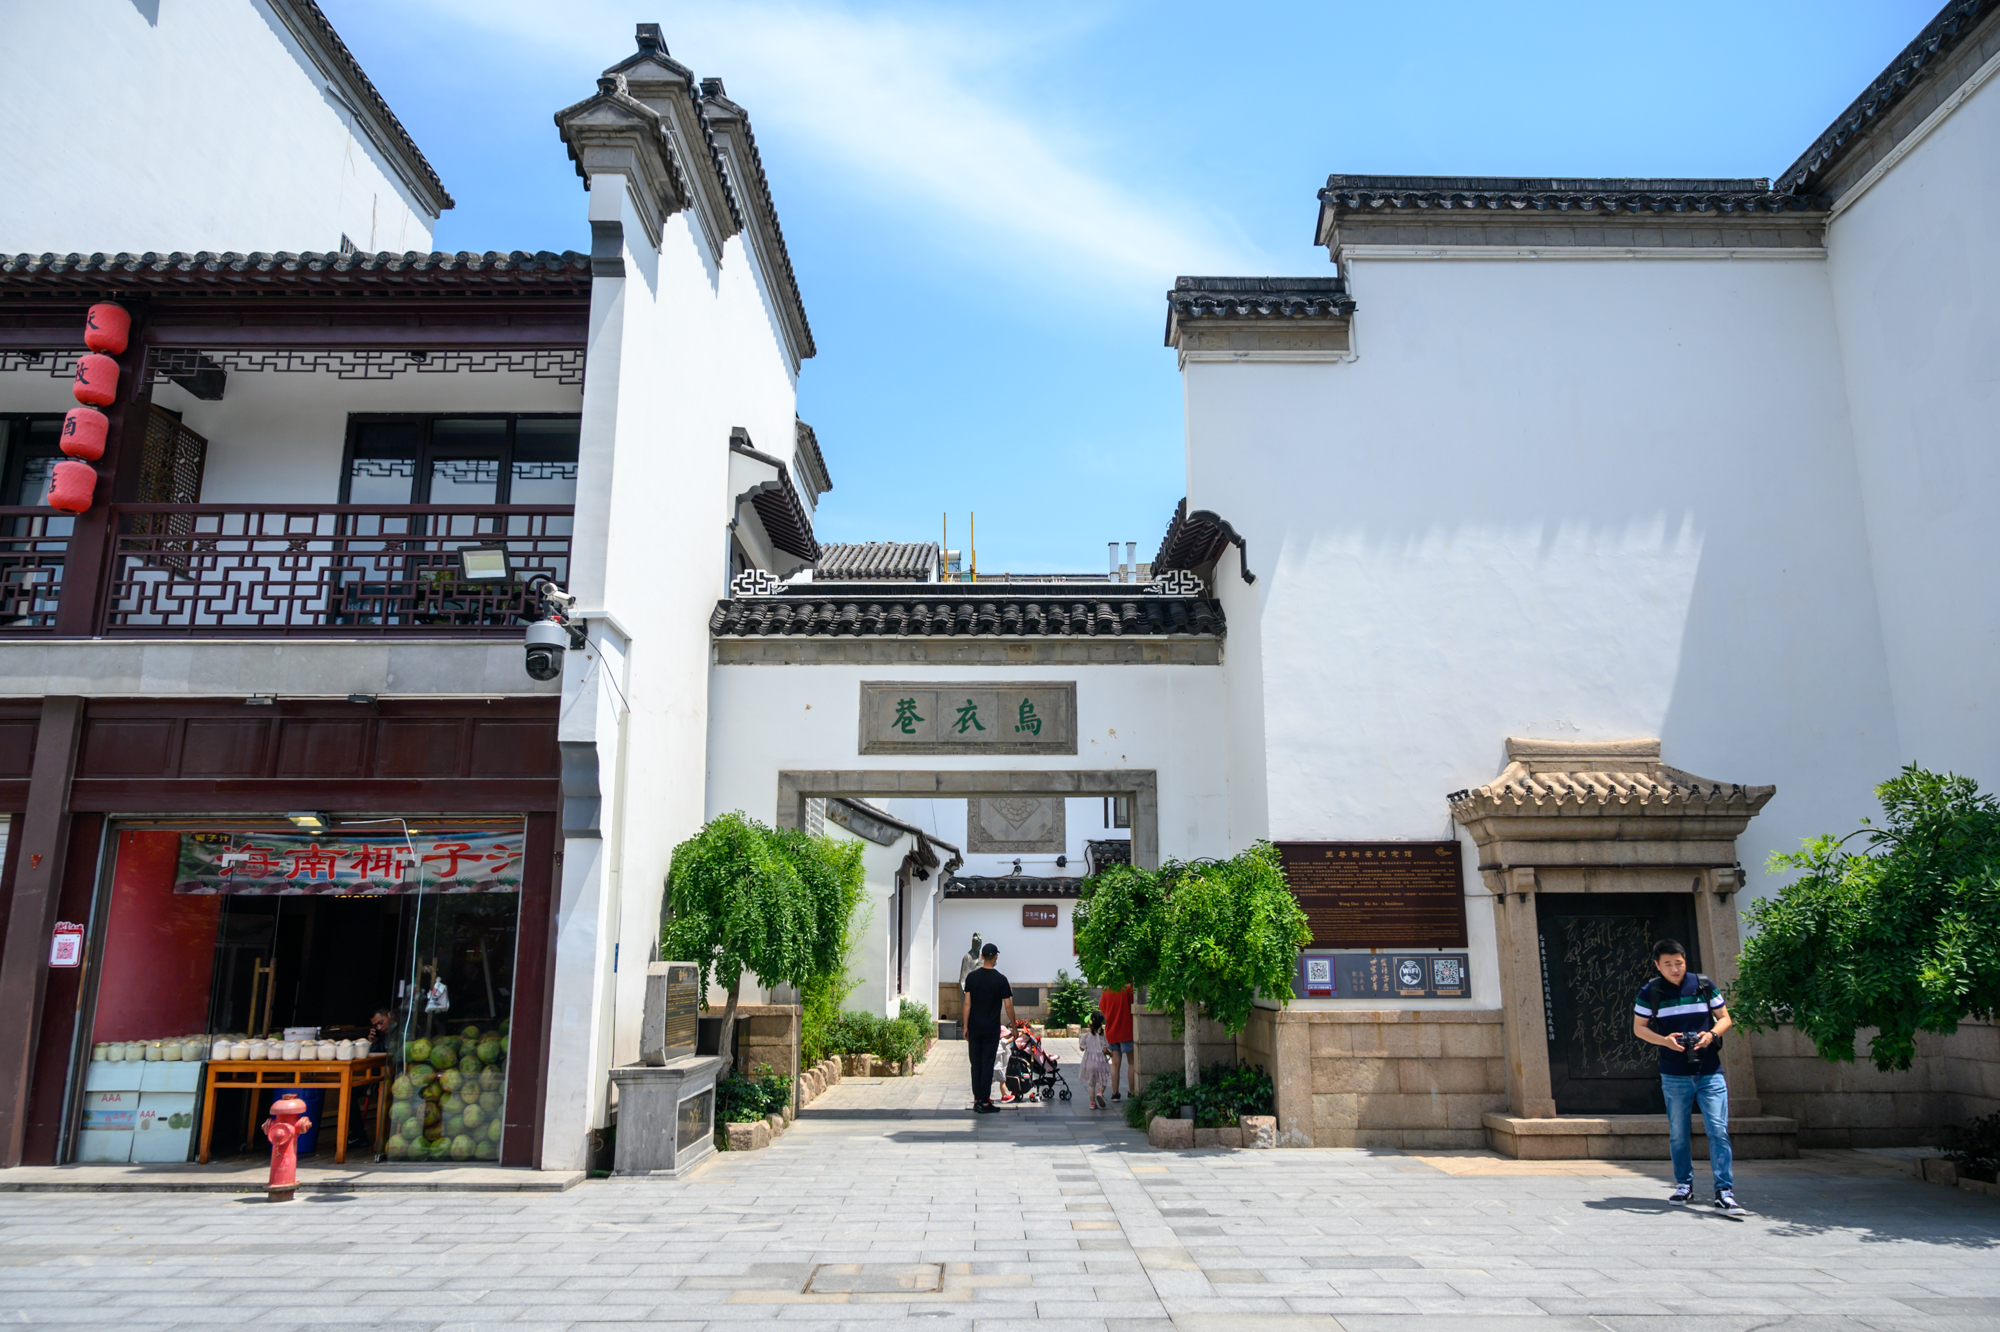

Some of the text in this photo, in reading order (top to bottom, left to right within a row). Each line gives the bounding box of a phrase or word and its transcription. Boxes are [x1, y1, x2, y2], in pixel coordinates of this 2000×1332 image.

[891, 697, 1043, 736] 烏衣巷
[101, 1093, 121, 1102] AAA
